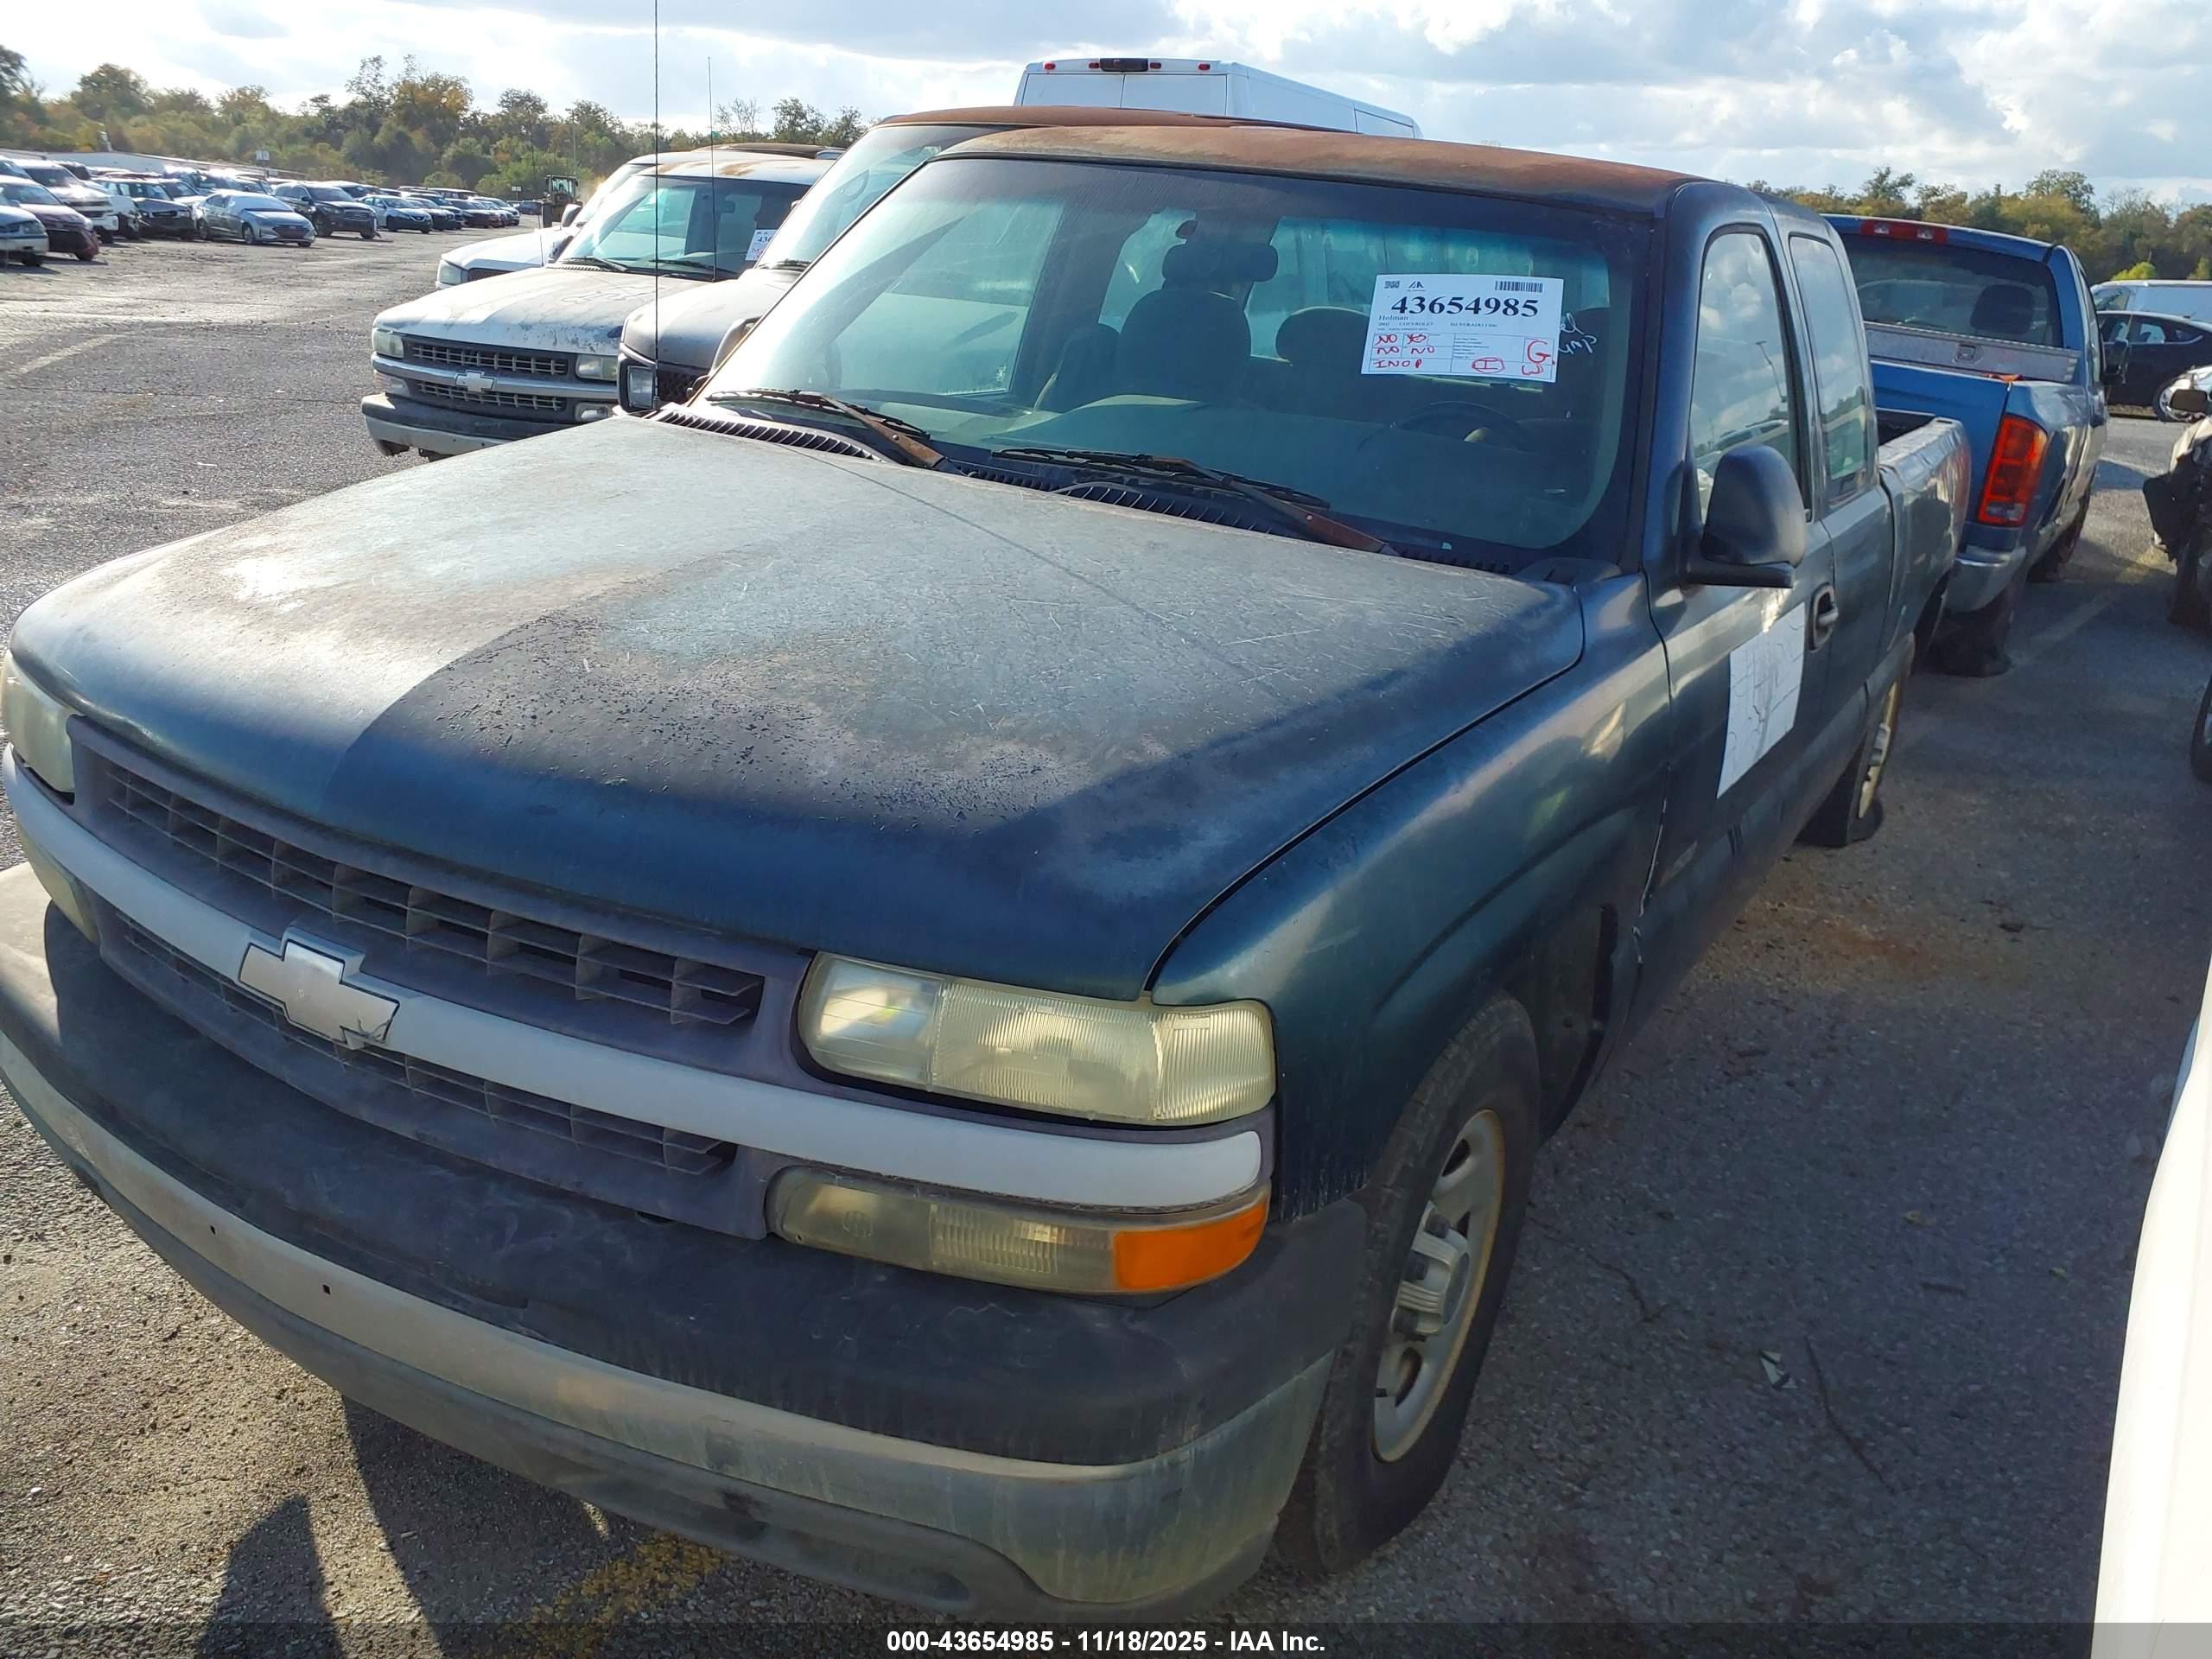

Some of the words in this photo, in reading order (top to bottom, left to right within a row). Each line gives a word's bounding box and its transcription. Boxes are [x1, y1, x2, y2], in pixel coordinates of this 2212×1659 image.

[1391, 296, 1539, 317] 43654985
[1560, 313, 1585, 334] el
[1375, 334, 1398, 346] NO
[1558, 335, 1598, 354] ump
[1410, 345, 1435, 354] NO
[1373, 359, 1423, 368] INOP
